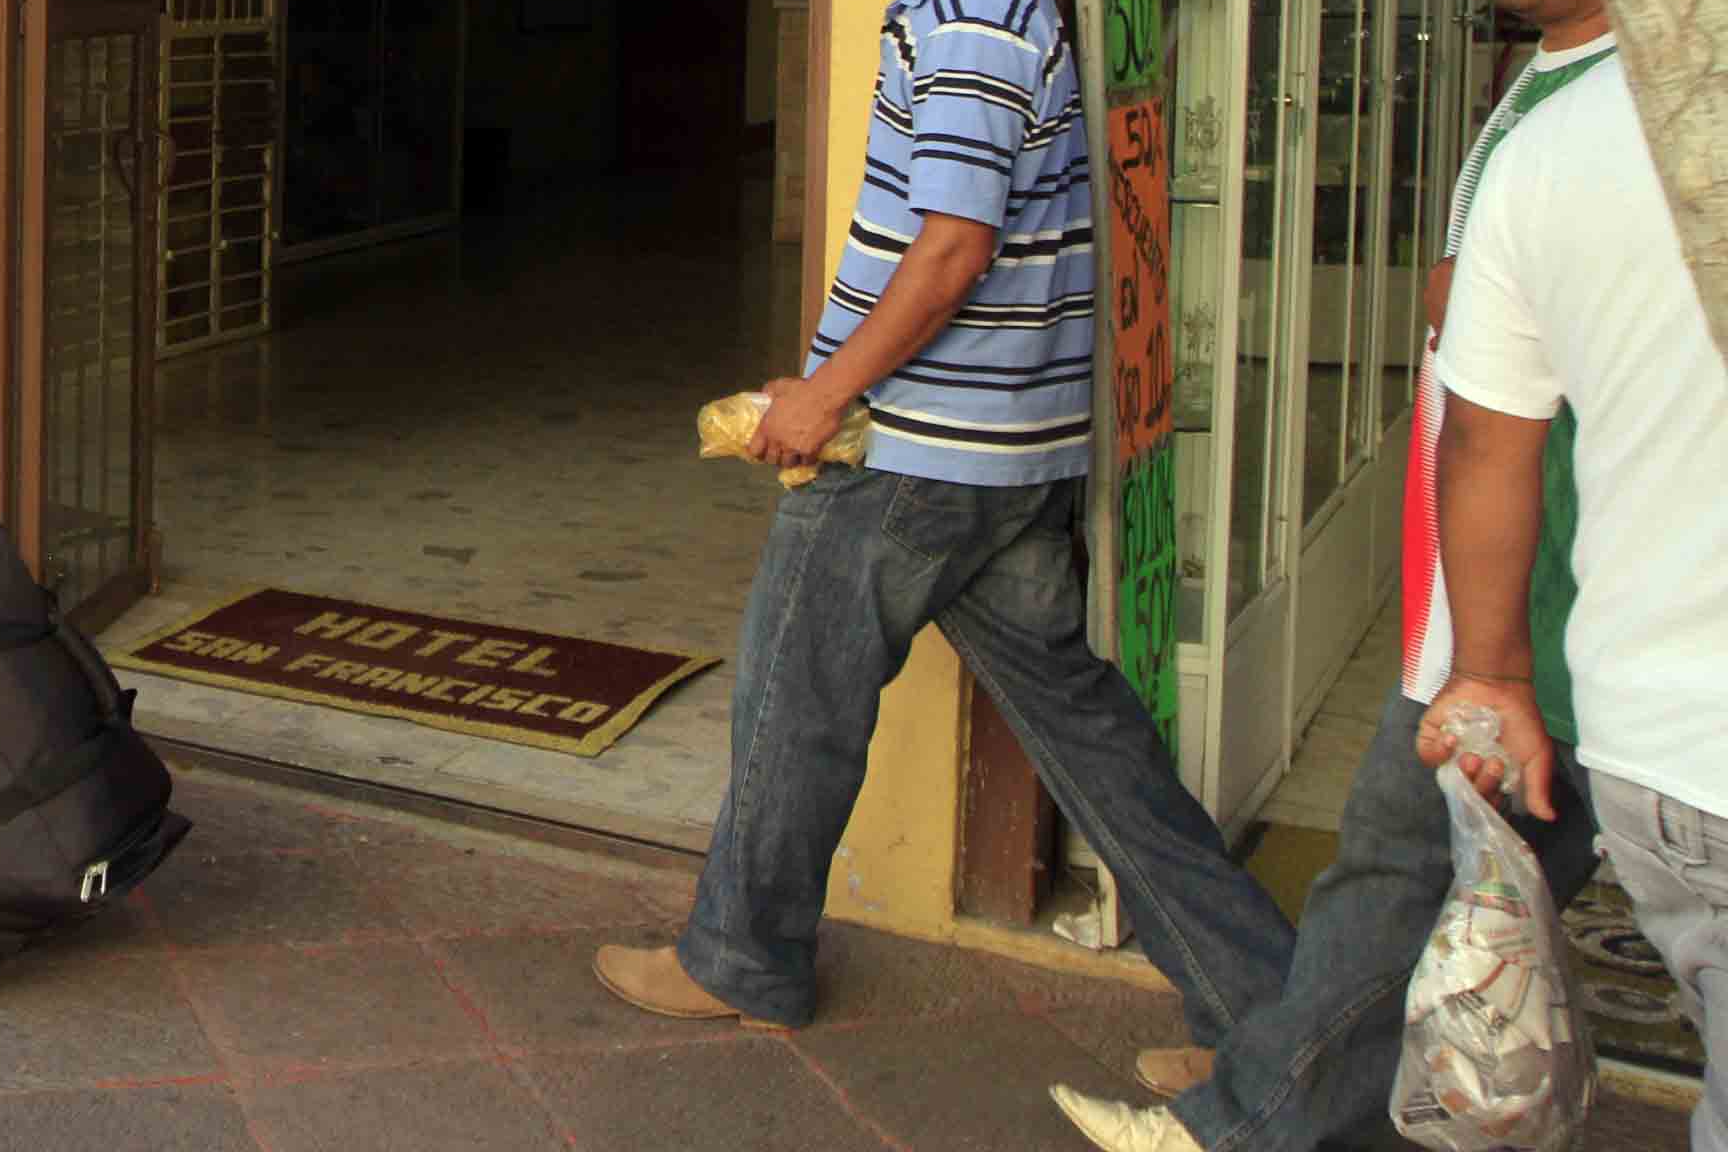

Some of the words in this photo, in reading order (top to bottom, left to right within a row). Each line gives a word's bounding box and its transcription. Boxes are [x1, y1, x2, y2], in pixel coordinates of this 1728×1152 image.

[166, 631, 280, 667] SAN
[281, 654, 610, 725] FRANCISCO
[292, 611, 559, 678] HOTEL
